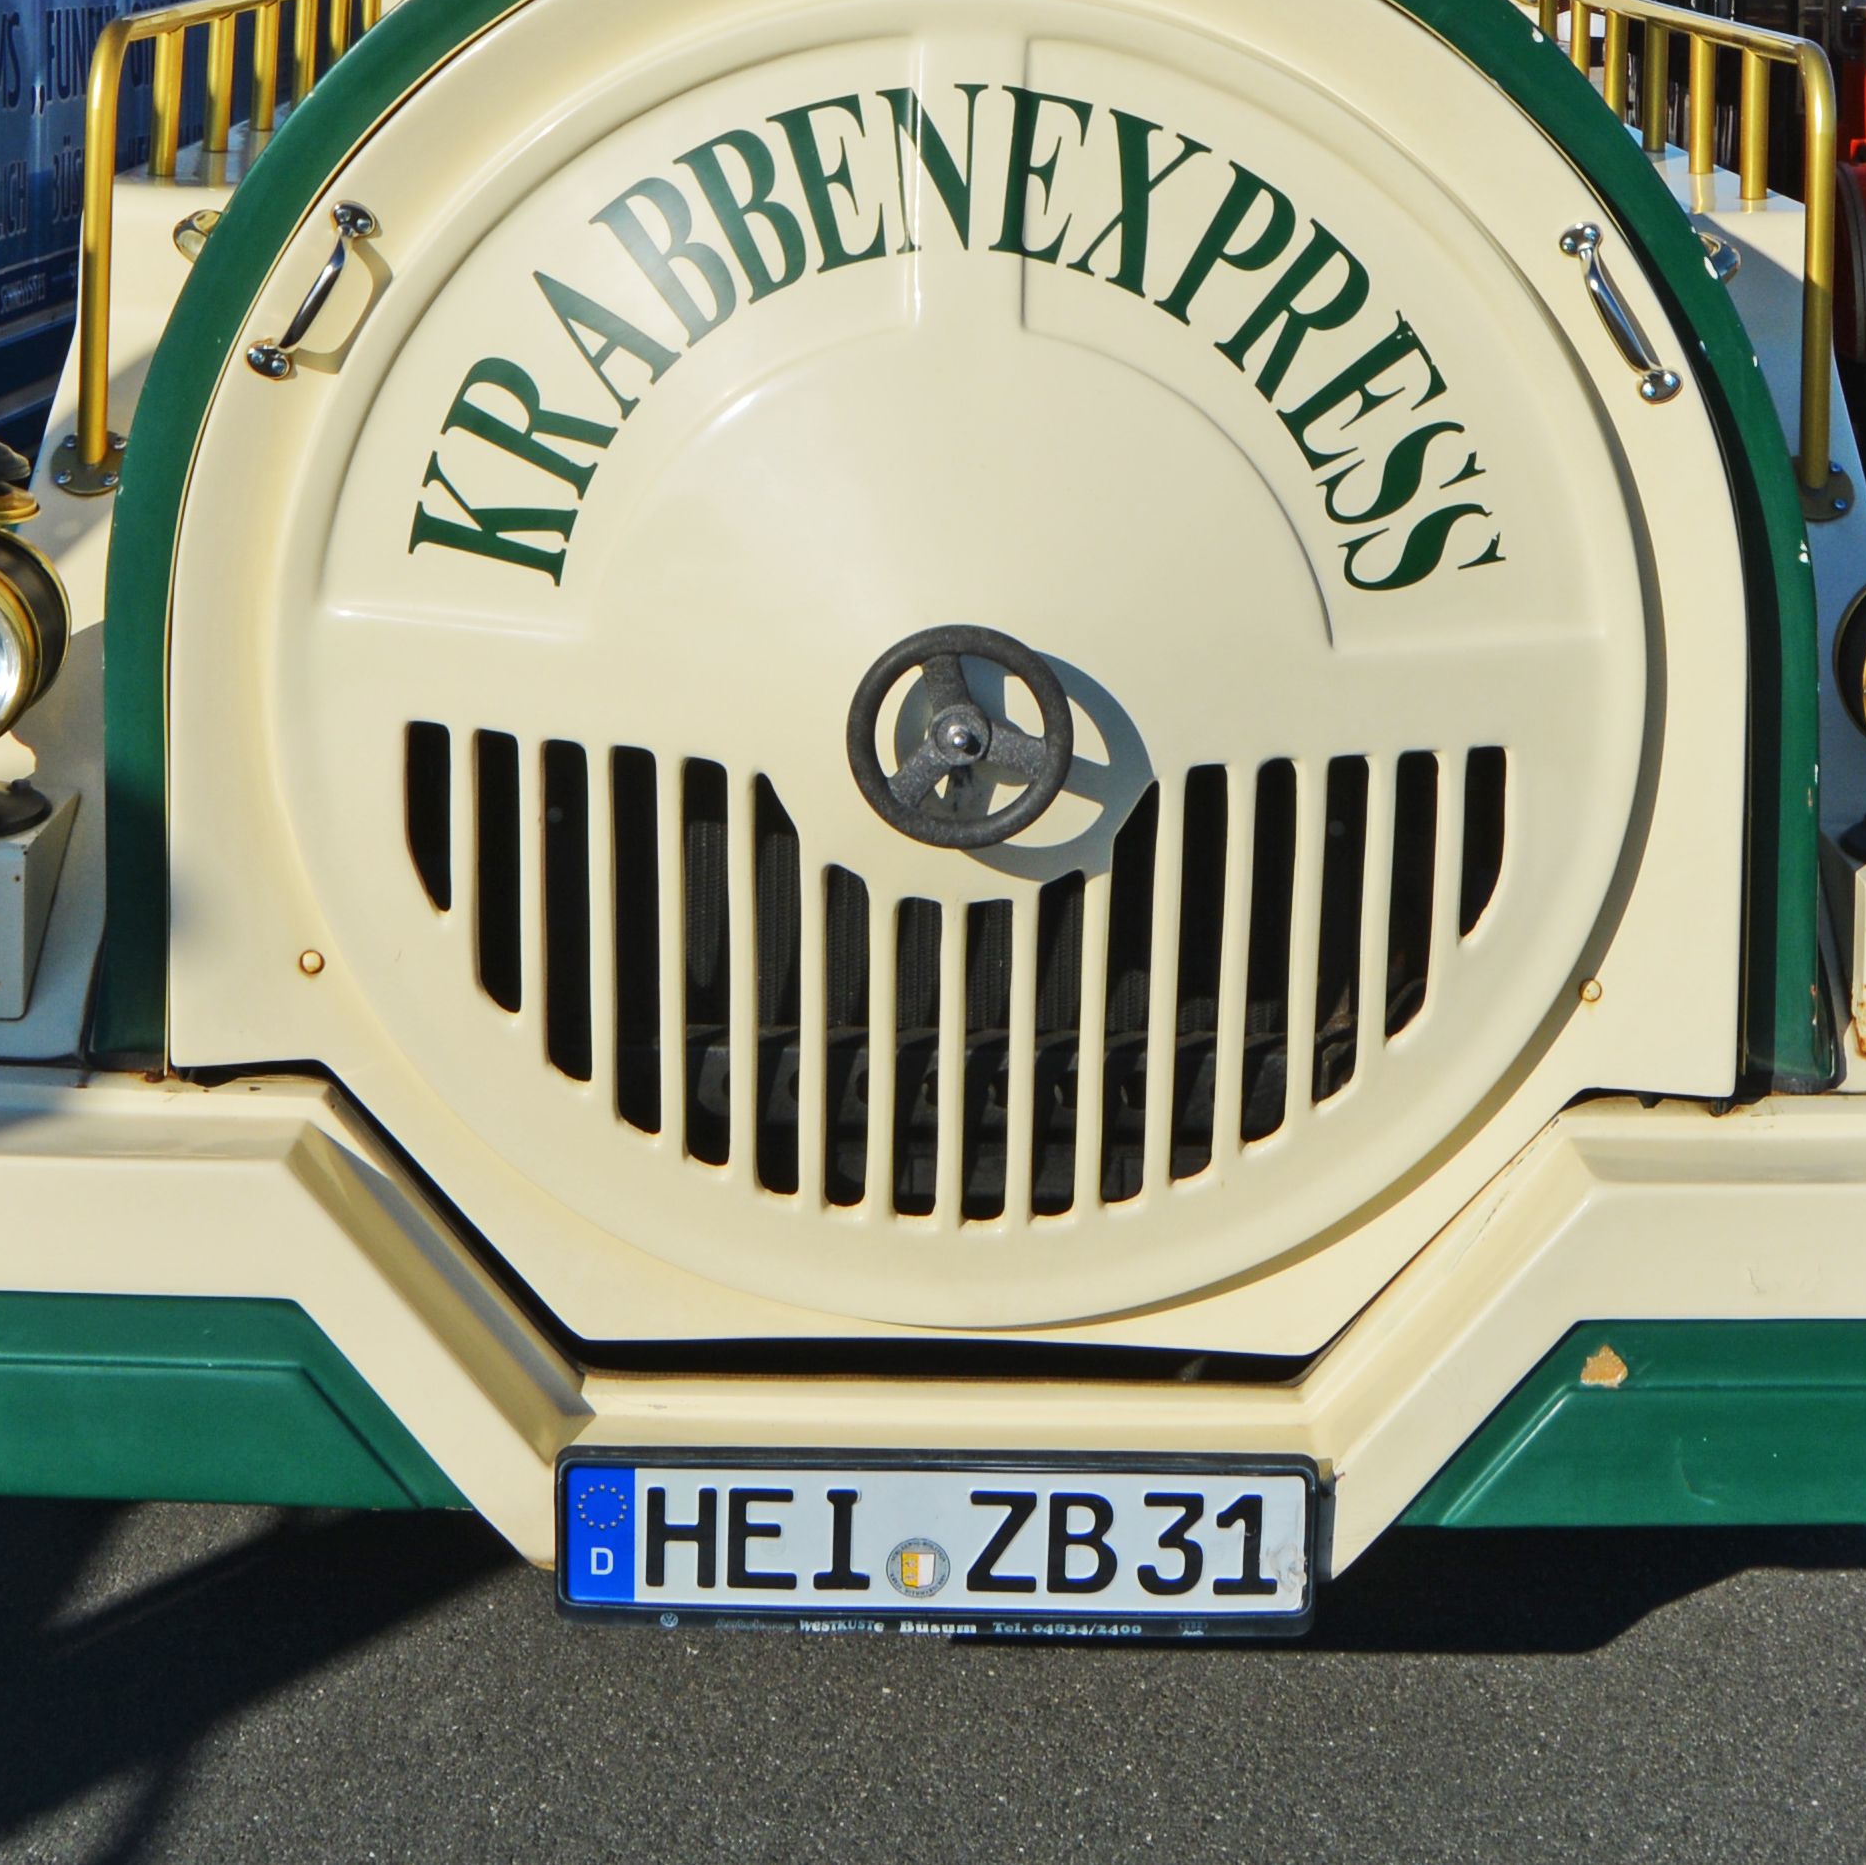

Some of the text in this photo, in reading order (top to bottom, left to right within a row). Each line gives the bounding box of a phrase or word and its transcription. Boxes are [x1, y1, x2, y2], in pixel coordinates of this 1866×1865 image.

[408, 83, 1507, 592] KRABBENEXPRESS
[590, 1547, 614, 1576] D
[645, 1486, 871, 1592] HEI
[899, 1620, 977, 1634] Büsum
[993, 1621, 1027, 1634] Tel.
[1032, 1621, 1142, 1636] 04834/2400
